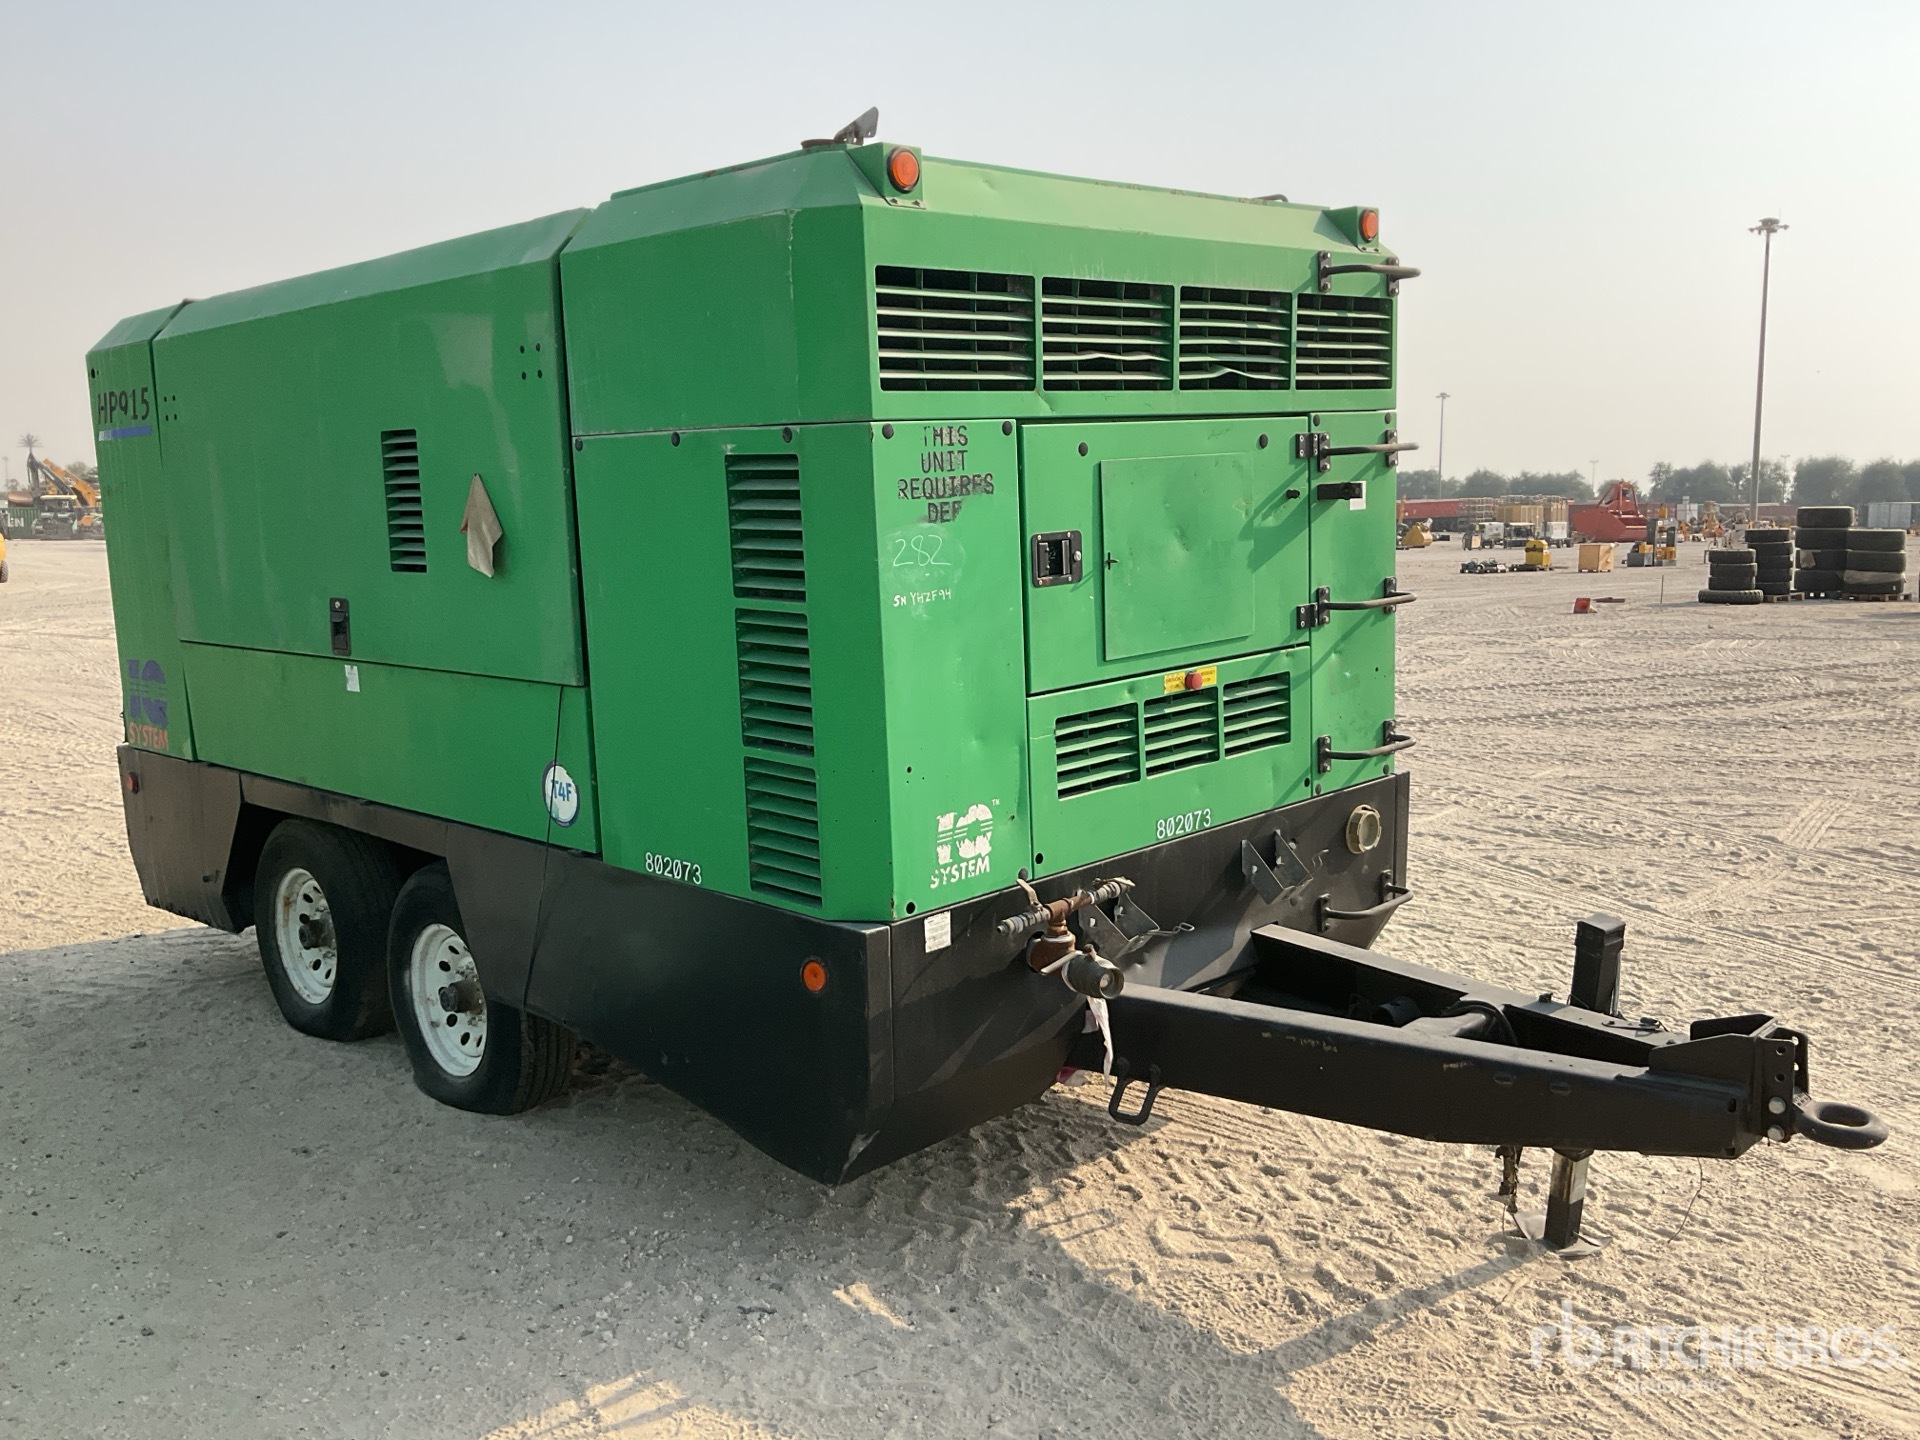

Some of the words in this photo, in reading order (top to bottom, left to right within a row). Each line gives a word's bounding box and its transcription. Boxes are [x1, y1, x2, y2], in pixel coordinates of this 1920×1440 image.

[97, 386, 150, 424] HP915
[922, 425, 968, 447] THIS
[921, 450, 968, 473] UNIT
[893, 535, 951, 566] 282
[893, 595, 907, 607] SN
[129, 721, 169, 751] SYSTEM
[551, 779, 572, 801] T4F
[1157, 808, 1212, 839] 802073
[645, 852, 702, 885] 802073
[930, 856, 990, 889] SYSTEM
